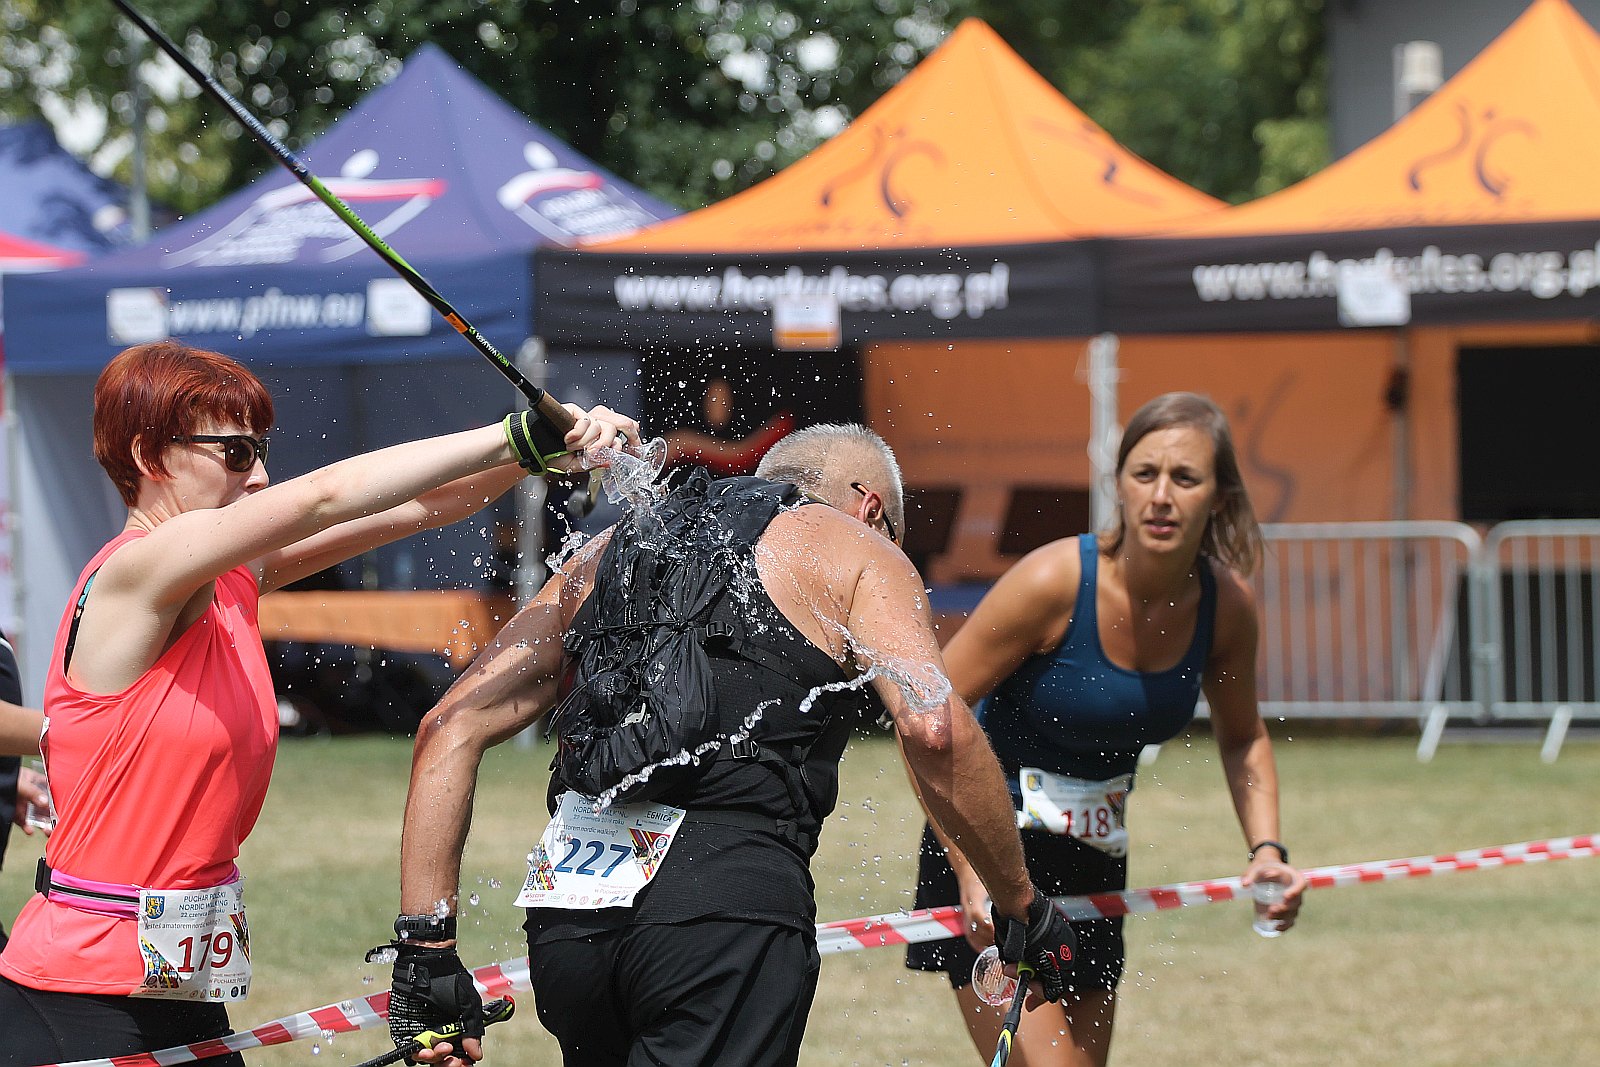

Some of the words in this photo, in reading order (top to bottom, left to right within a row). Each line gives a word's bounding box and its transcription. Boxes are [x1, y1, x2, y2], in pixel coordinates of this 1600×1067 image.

[1192, 238, 1600, 300] www.hules.org.p
[1061, 807, 1110, 838] 118
[554, 837, 632, 878] 227
[178, 931, 234, 973] 179
